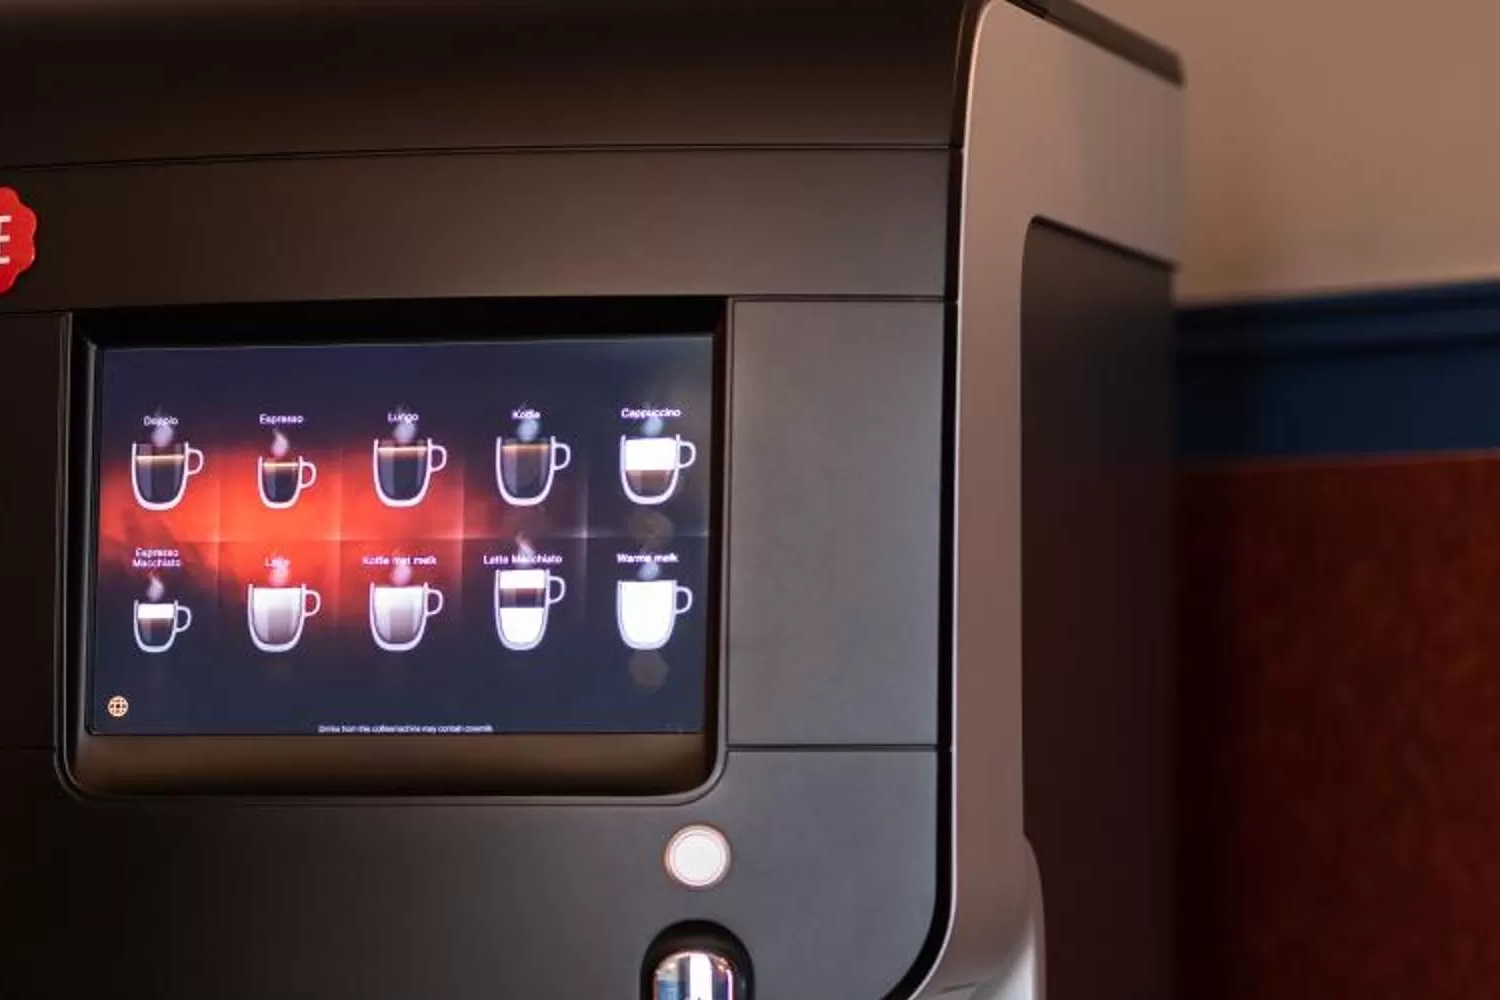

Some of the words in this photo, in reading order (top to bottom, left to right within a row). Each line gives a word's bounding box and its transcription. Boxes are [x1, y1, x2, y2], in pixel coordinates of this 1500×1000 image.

[259, 413, 304, 425] Espresso
[387, 412, 419, 424] Lungo
[621, 408, 681, 419] Cappuccino
[135, 547, 179, 558] Espresso
[616, 553, 652, 563] Warme
[483, 555, 508, 565] Latte
